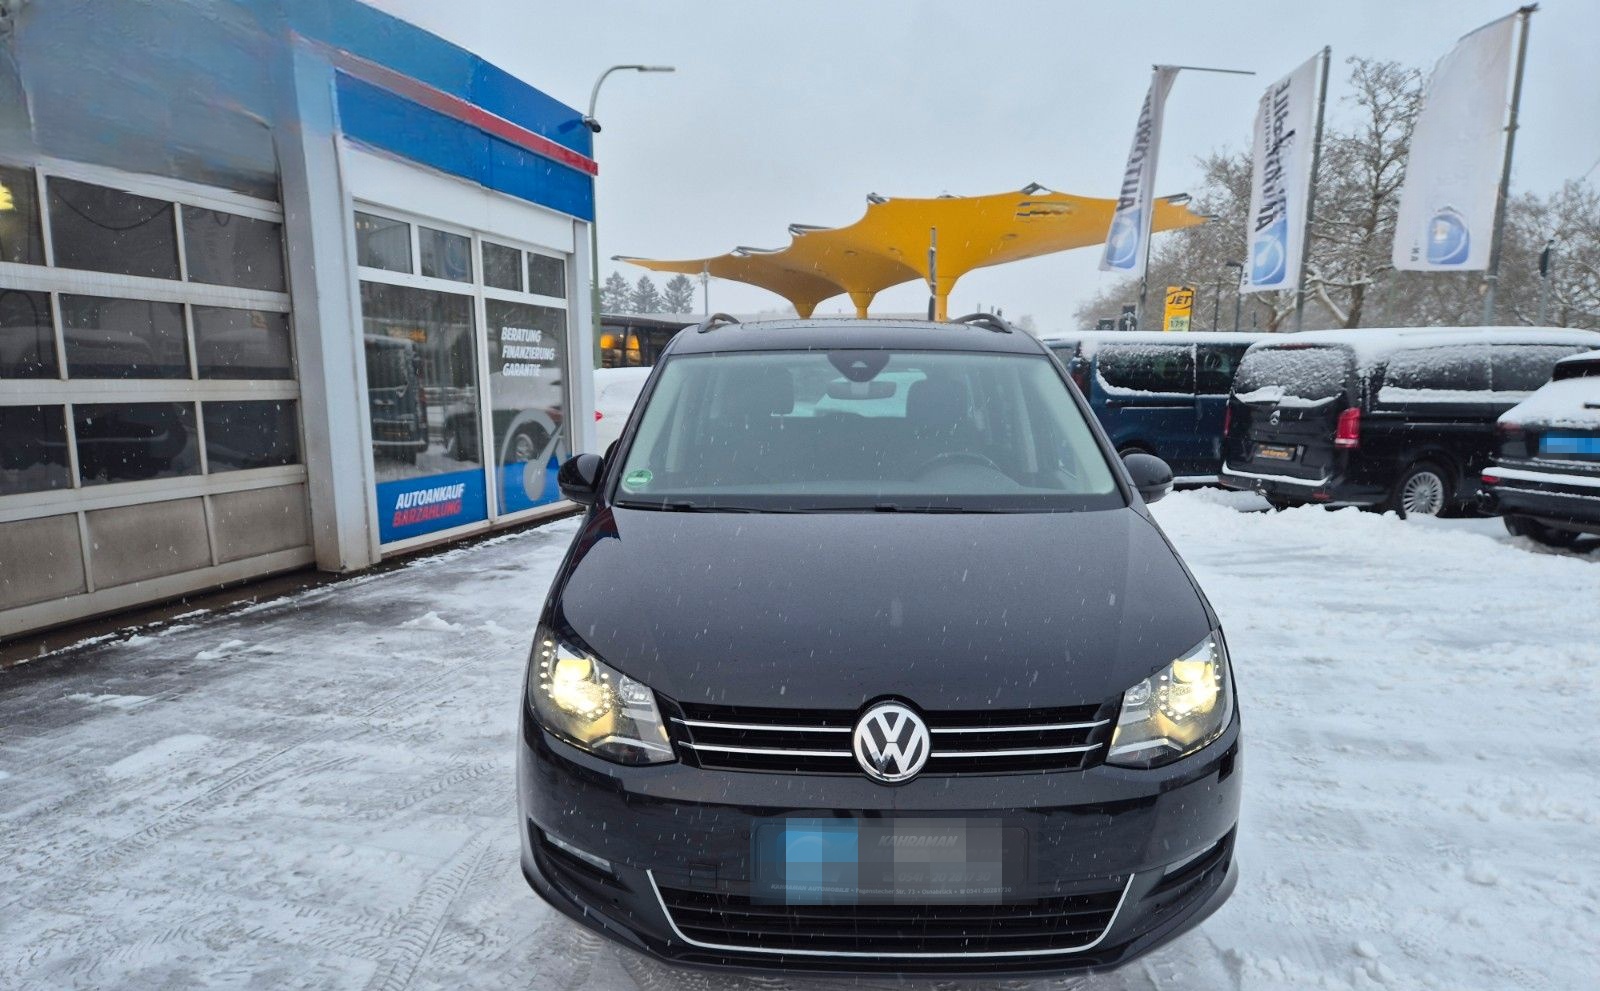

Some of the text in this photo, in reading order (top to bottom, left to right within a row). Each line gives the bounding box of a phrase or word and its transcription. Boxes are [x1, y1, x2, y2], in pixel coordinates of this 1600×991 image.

[1168, 295, 1192, 304] JET
[501, 327, 542, 342] BERATUNG
[502, 345, 555, 360] FINANZIERUNG
[503, 363, 541, 376] GARANTIE
[395, 483, 465, 509] AUTOANKAUF
[392, 499, 462, 527] BARZAHLUNG
[856, 707, 929, 779] VW
[878, 835, 959, 847] KAHRAMAN
